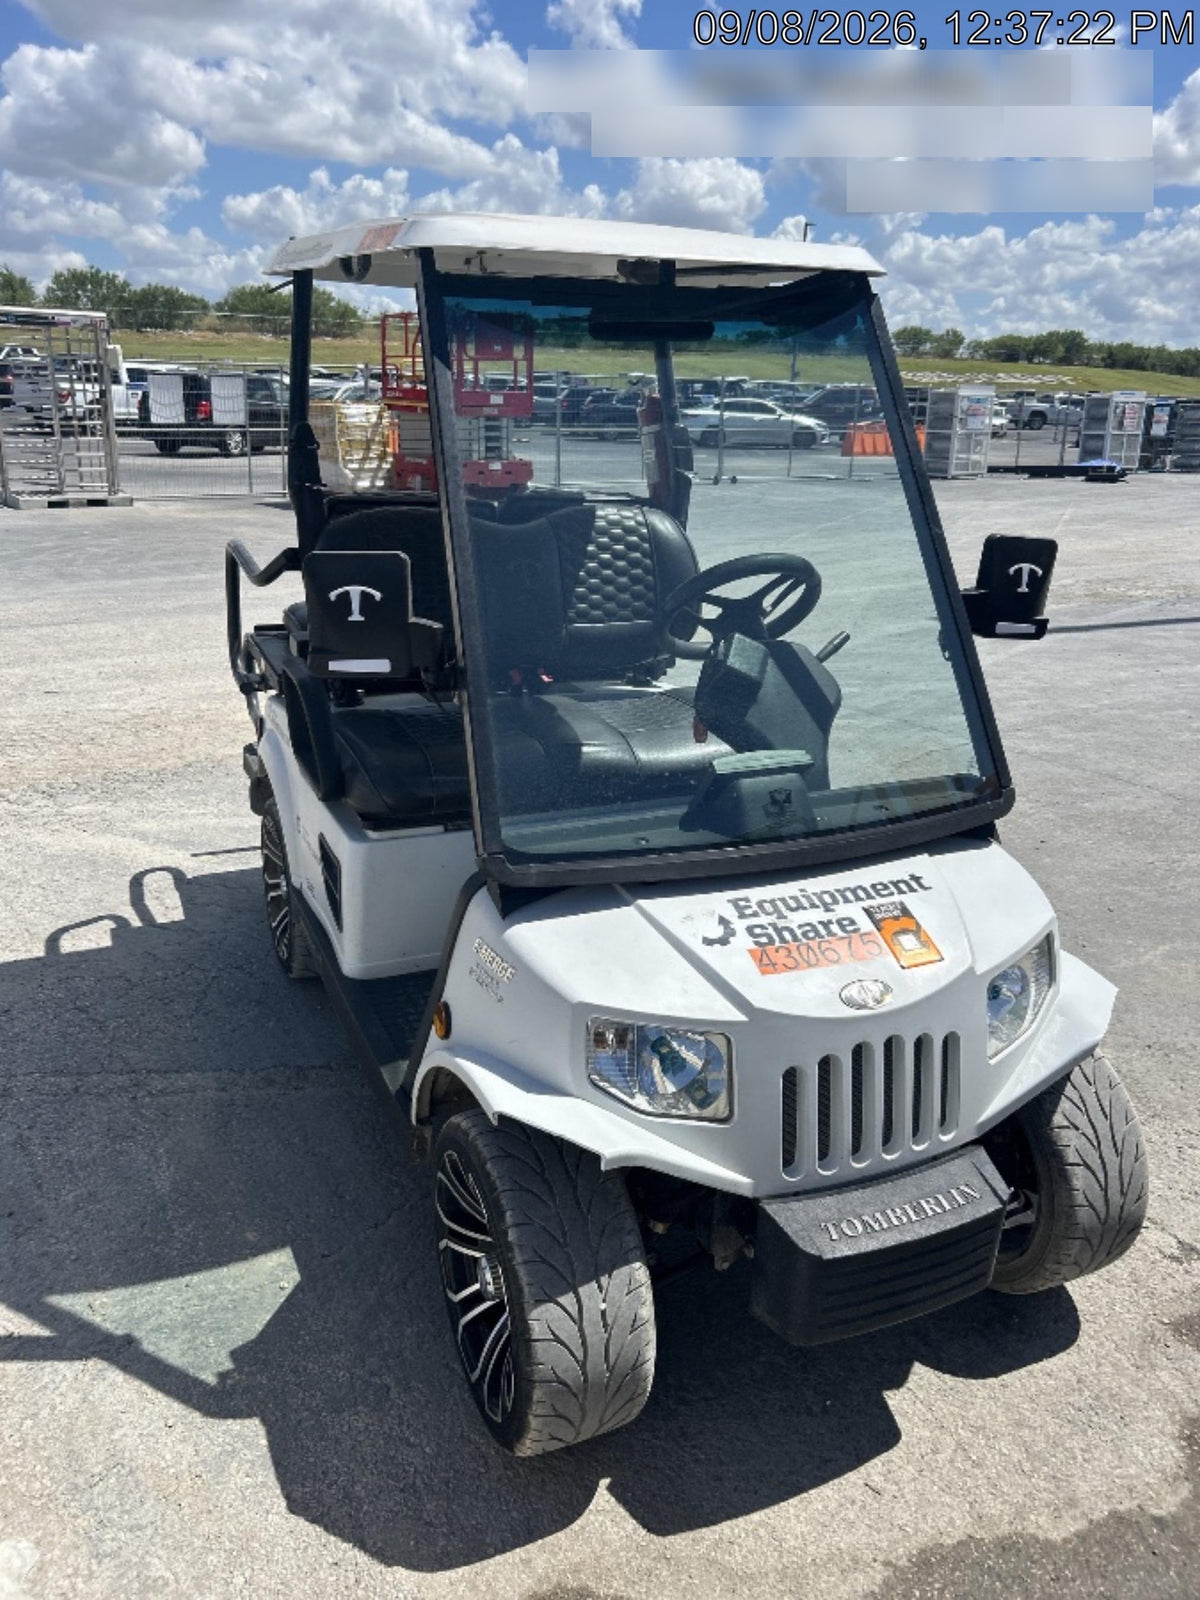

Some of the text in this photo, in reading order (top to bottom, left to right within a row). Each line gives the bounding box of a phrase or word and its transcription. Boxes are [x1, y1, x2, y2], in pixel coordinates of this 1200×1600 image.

[328, 585, 382, 621] T
[726, 872, 932, 920] Equipment
[745, 914, 862, 948] Share
[758, 931, 883, 973] 430675
[820, 1183, 983, 1241] TOMBERLIN
